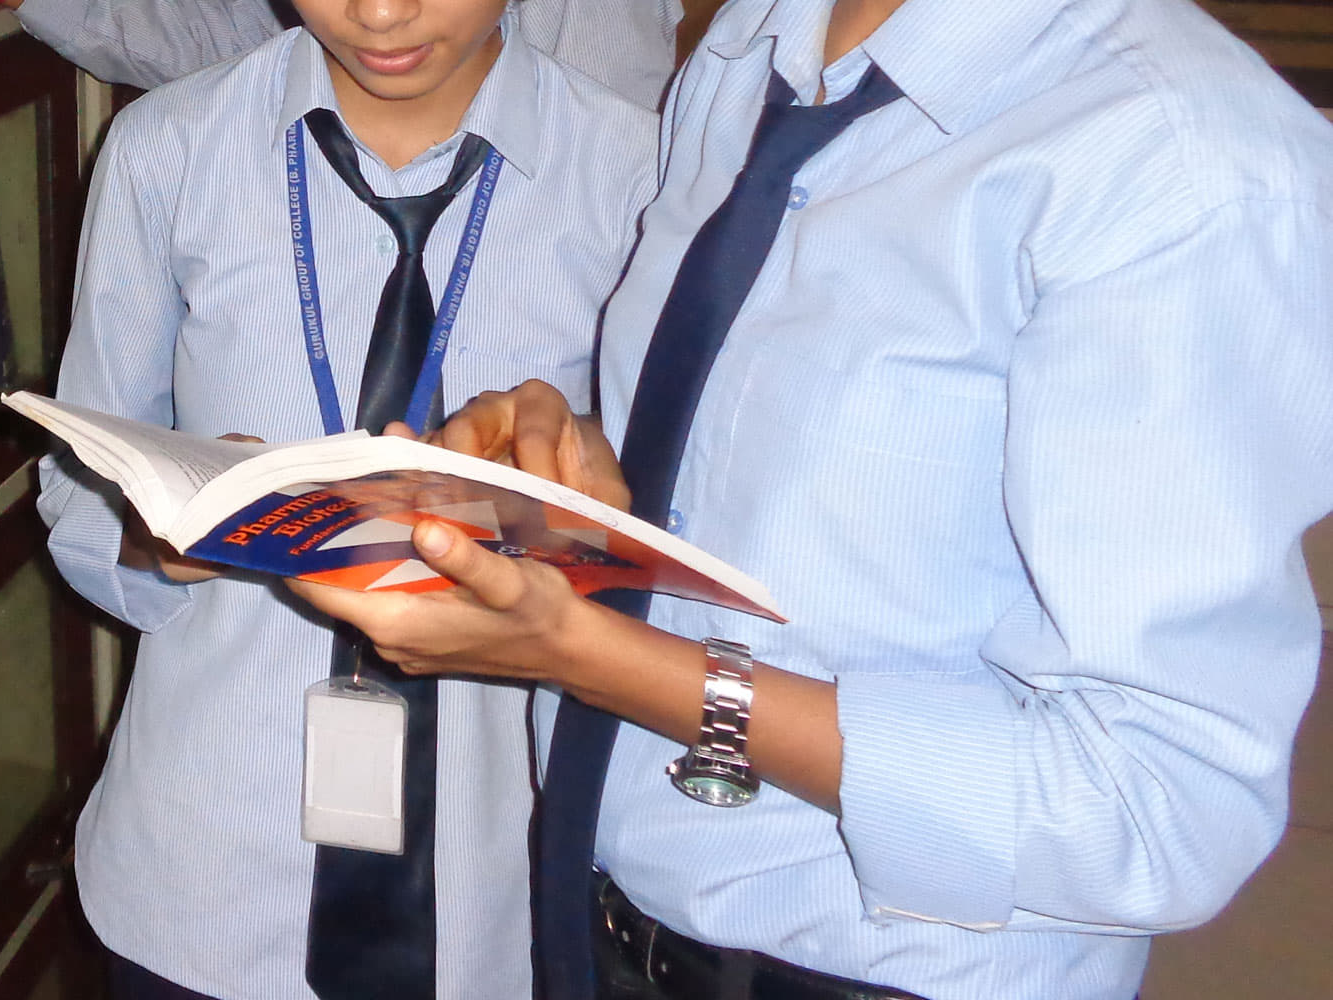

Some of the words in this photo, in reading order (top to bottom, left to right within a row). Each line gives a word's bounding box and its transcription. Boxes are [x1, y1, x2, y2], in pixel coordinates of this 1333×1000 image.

[482, 178, 493, 195] OF
[289, 186, 303, 241] COLLEGE
[467, 195, 487, 253] COLLEGE
[294, 242, 305, 258] OF
[298, 262, 312, 300] GROUP
[308, 303, 324, 360] GURUKUL
